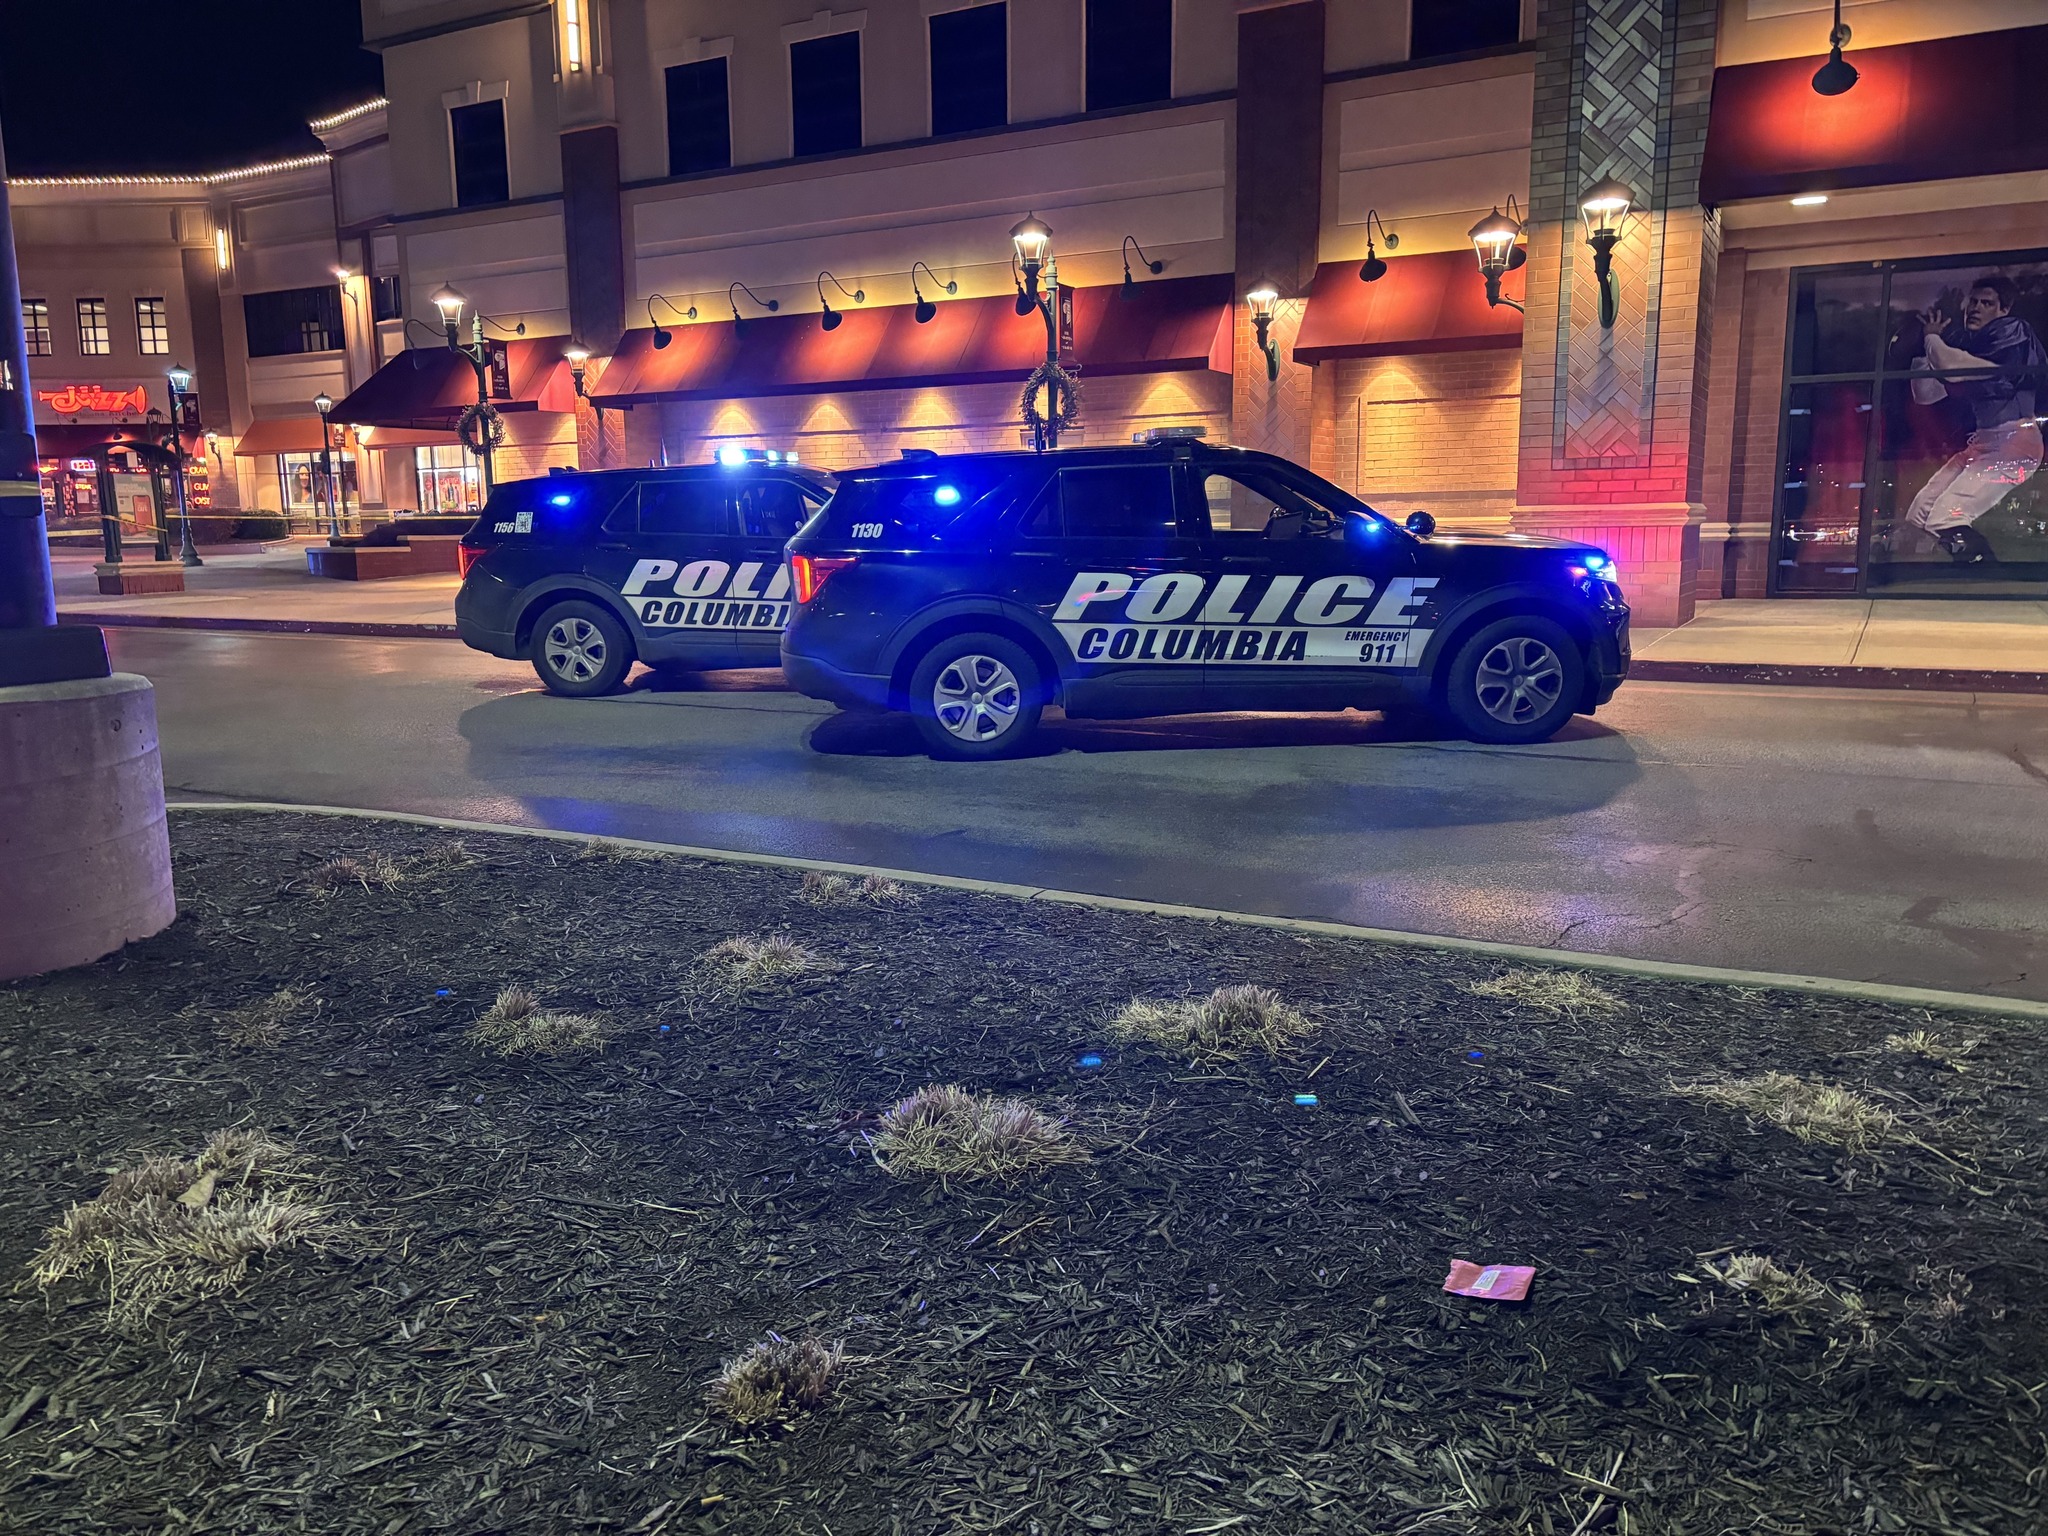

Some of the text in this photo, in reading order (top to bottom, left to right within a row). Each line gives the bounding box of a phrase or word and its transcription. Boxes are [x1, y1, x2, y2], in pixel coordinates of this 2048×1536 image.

[493, 522, 515, 533] 1156
[851, 523, 884, 538] 1130
[620, 558, 791, 600] POLI
[1052, 572, 1440, 626] POLICE
[640, 600, 791, 628] COLUMBI
[1077, 627, 1309, 661] COLUMBIA
[1344, 631, 1409, 642] EMERGENCY
[1359, 643, 1397, 663] 911
